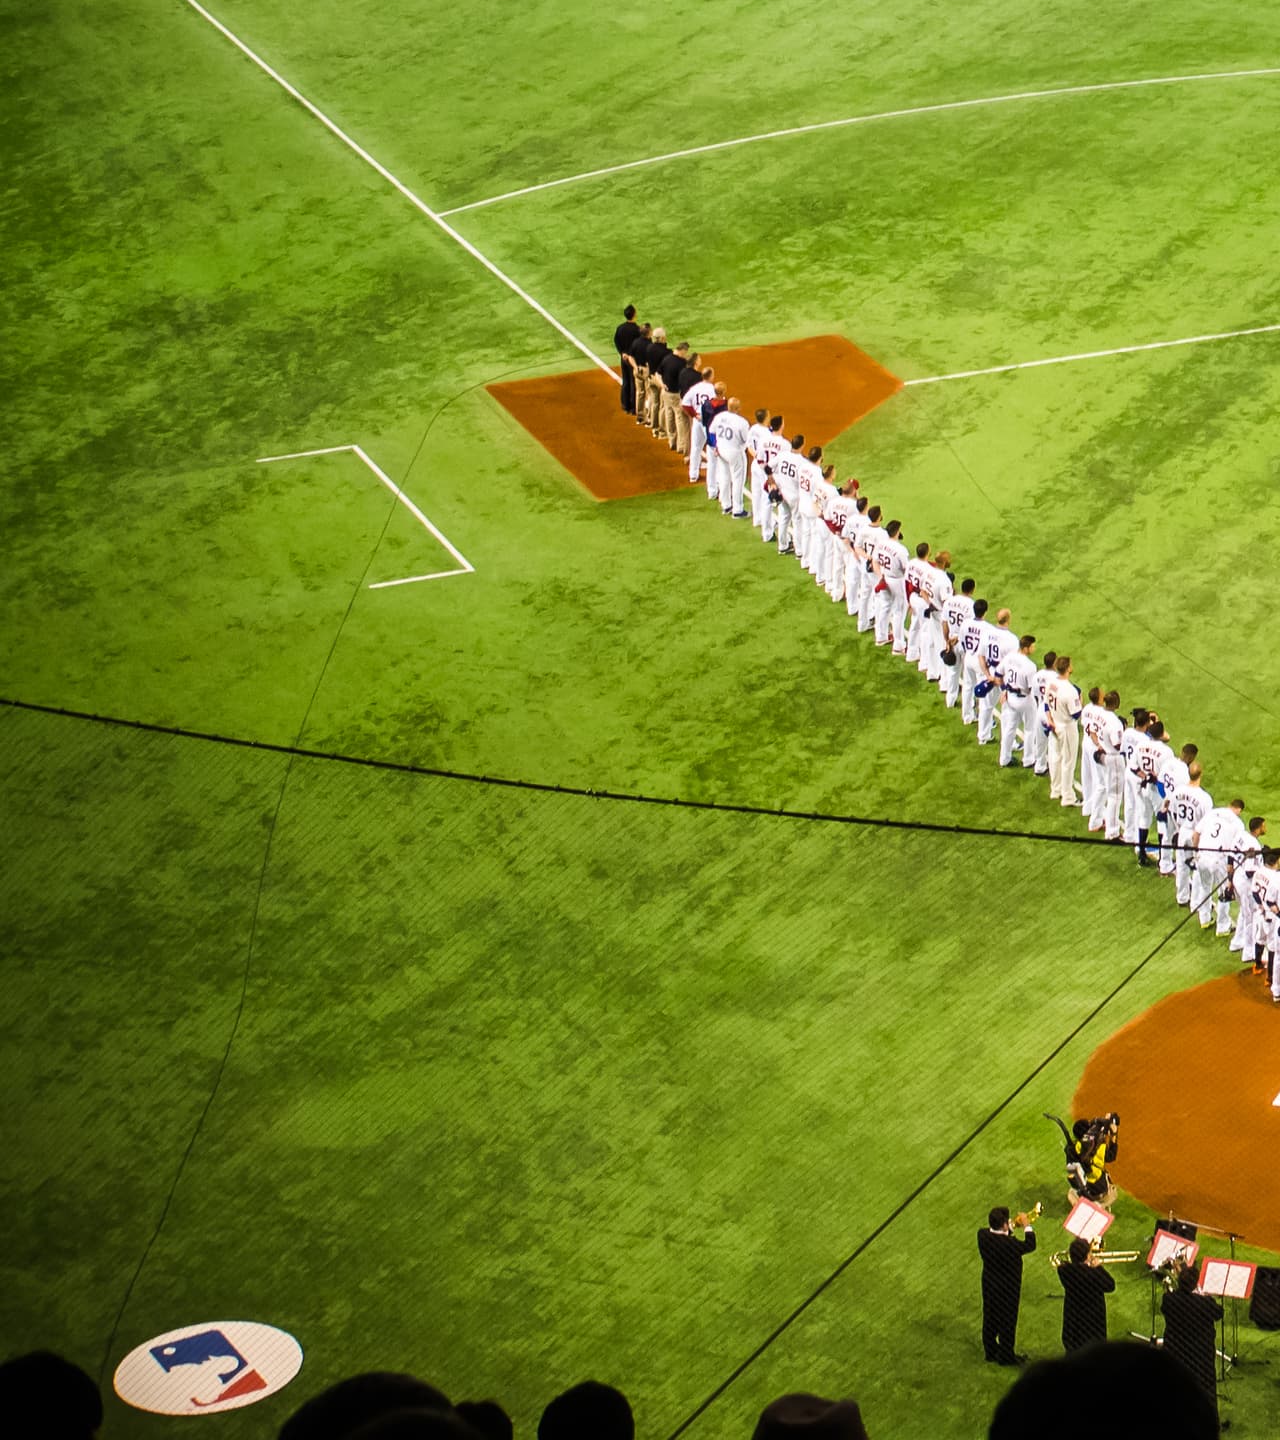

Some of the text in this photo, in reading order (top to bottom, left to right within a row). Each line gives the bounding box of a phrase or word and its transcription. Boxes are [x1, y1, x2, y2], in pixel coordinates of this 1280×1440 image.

[718, 425, 733, 441] 20
[780, 460, 796, 478] 26
[878, 553, 891, 570] 52
[964, 635, 980, 655] 67
[988, 643, 1000, 659] 19
[1007, 669, 1018, 683] 31
[1178, 803, 1194, 822] 33
[1211, 822, 1222, 838] 3
